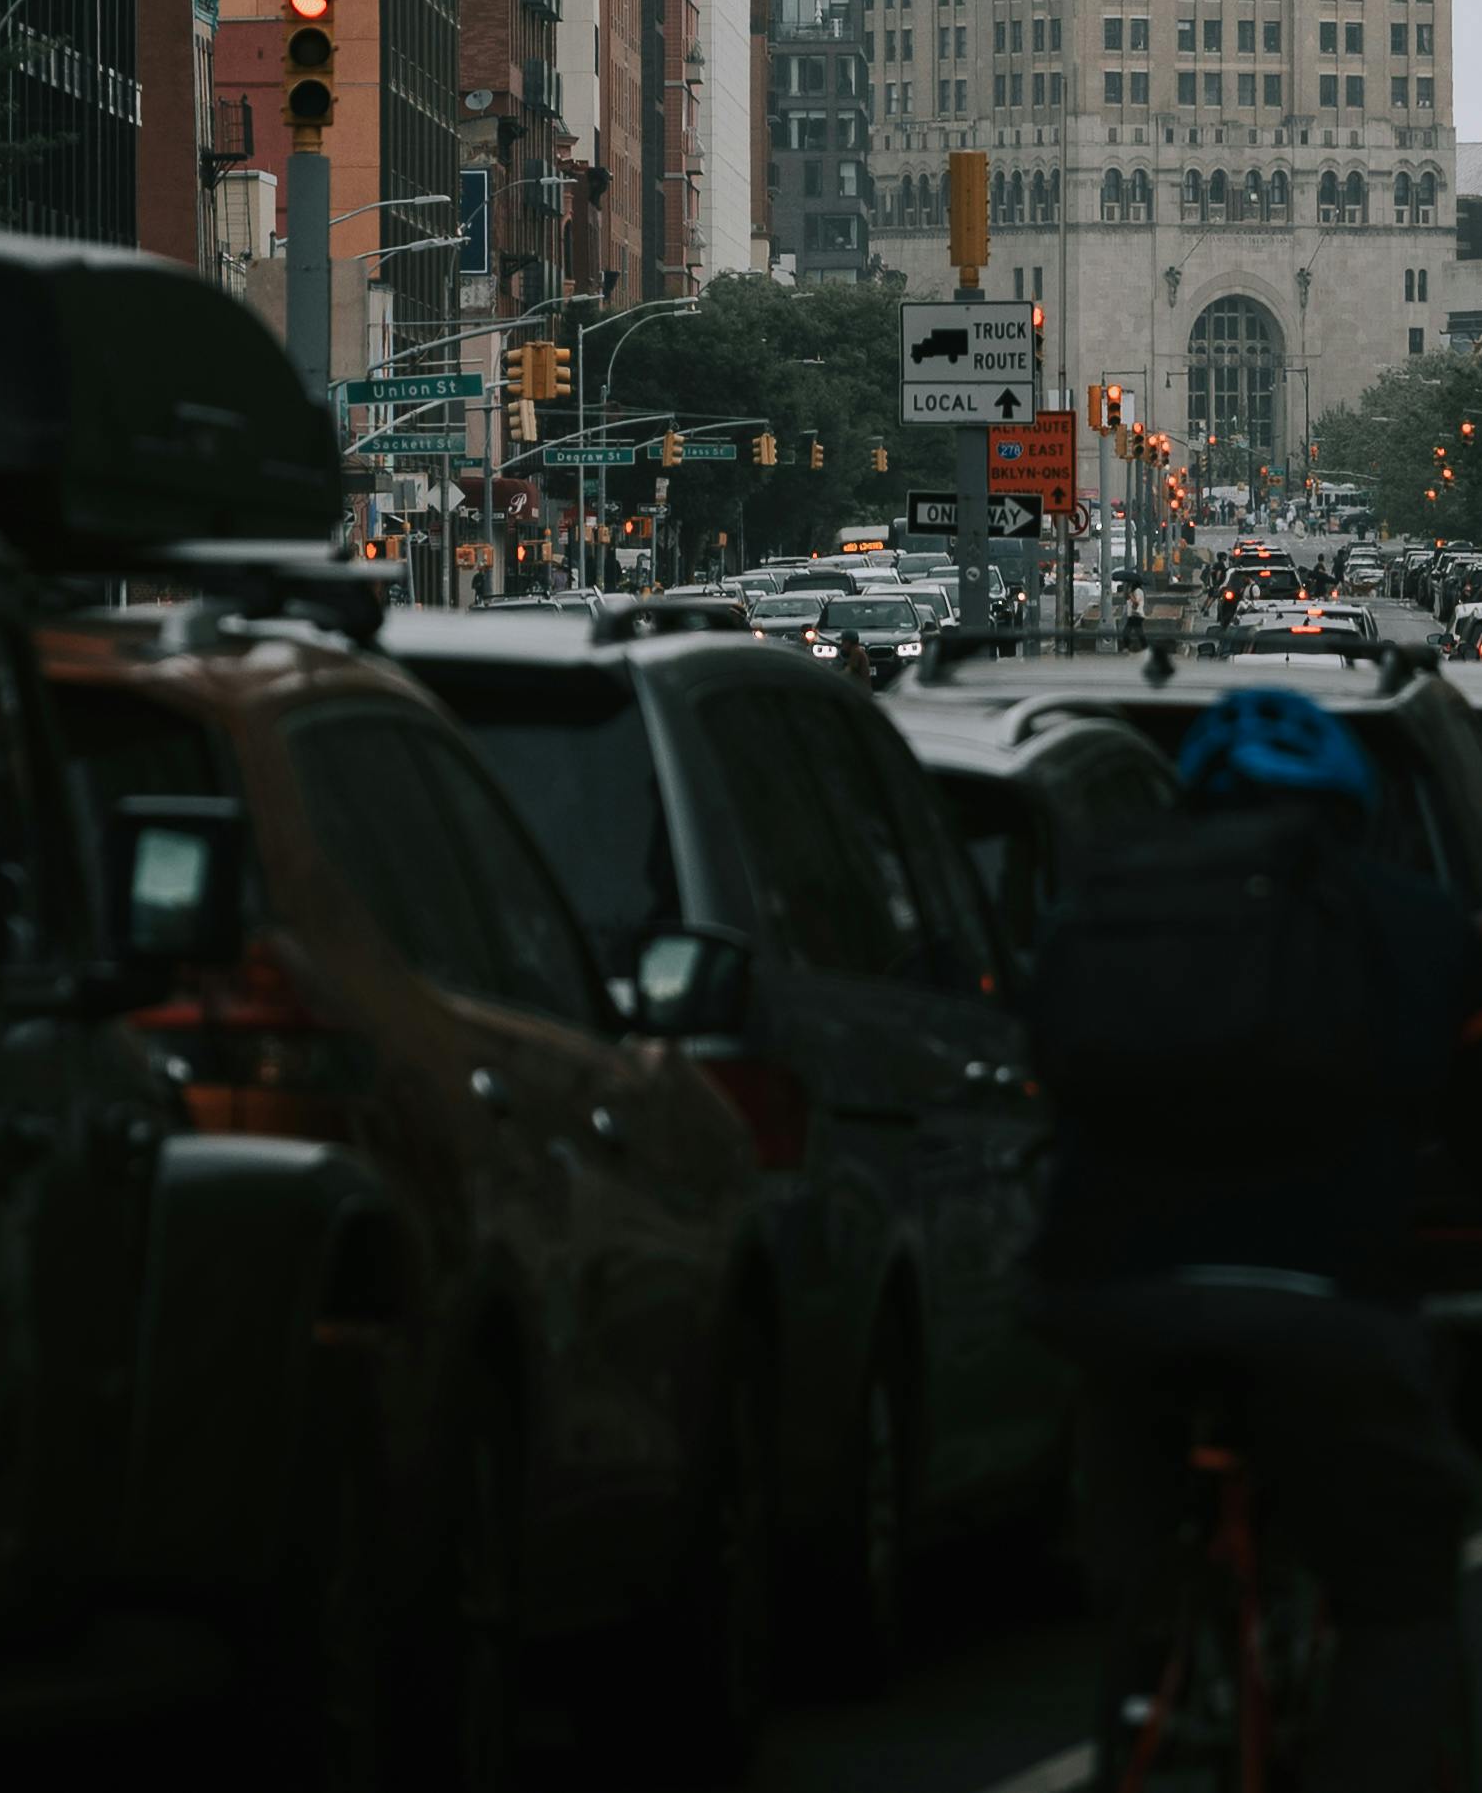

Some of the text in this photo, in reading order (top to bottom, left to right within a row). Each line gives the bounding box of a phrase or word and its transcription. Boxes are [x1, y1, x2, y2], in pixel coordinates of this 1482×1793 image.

[973, 322, 1027, 339] TRUCK
[973, 352, 1027, 370] ROUTE
[372, 380, 456, 399] Union St
[913, 394, 978, 412] LOCAL
[372, 438, 452, 449] Sackett St
[1029, 444, 1064, 456] EAST
[557, 451, 621, 462] Degraw St
[992, 467, 1070, 480] BKLYN-QNS
[927, 505, 958, 522] ON
